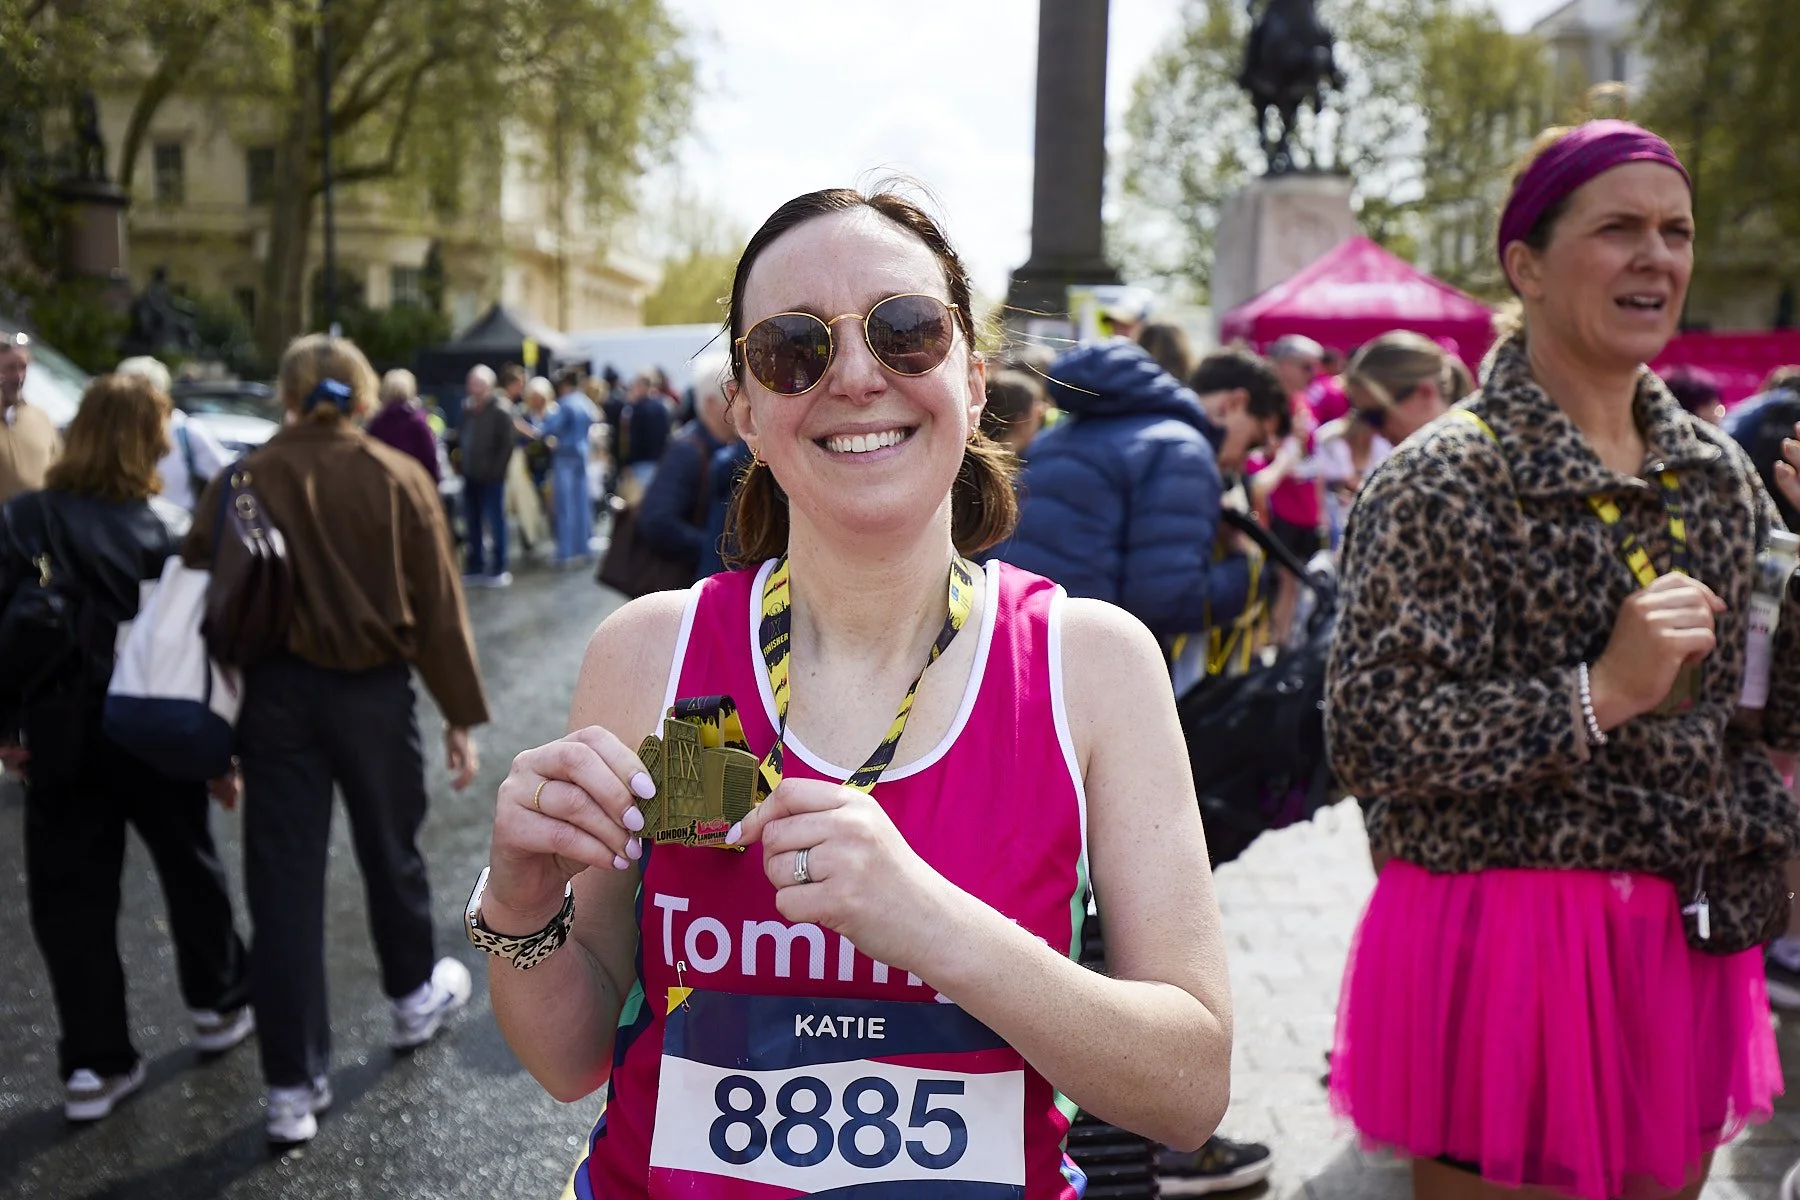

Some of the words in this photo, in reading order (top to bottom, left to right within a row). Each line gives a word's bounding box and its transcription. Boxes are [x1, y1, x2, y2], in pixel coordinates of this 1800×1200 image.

[763, 632, 789, 658] FINISHER
[656, 826, 688, 841] LONDON
[795, 1014, 886, 1039] KATIE
[709, 1075, 968, 1170] 8885
